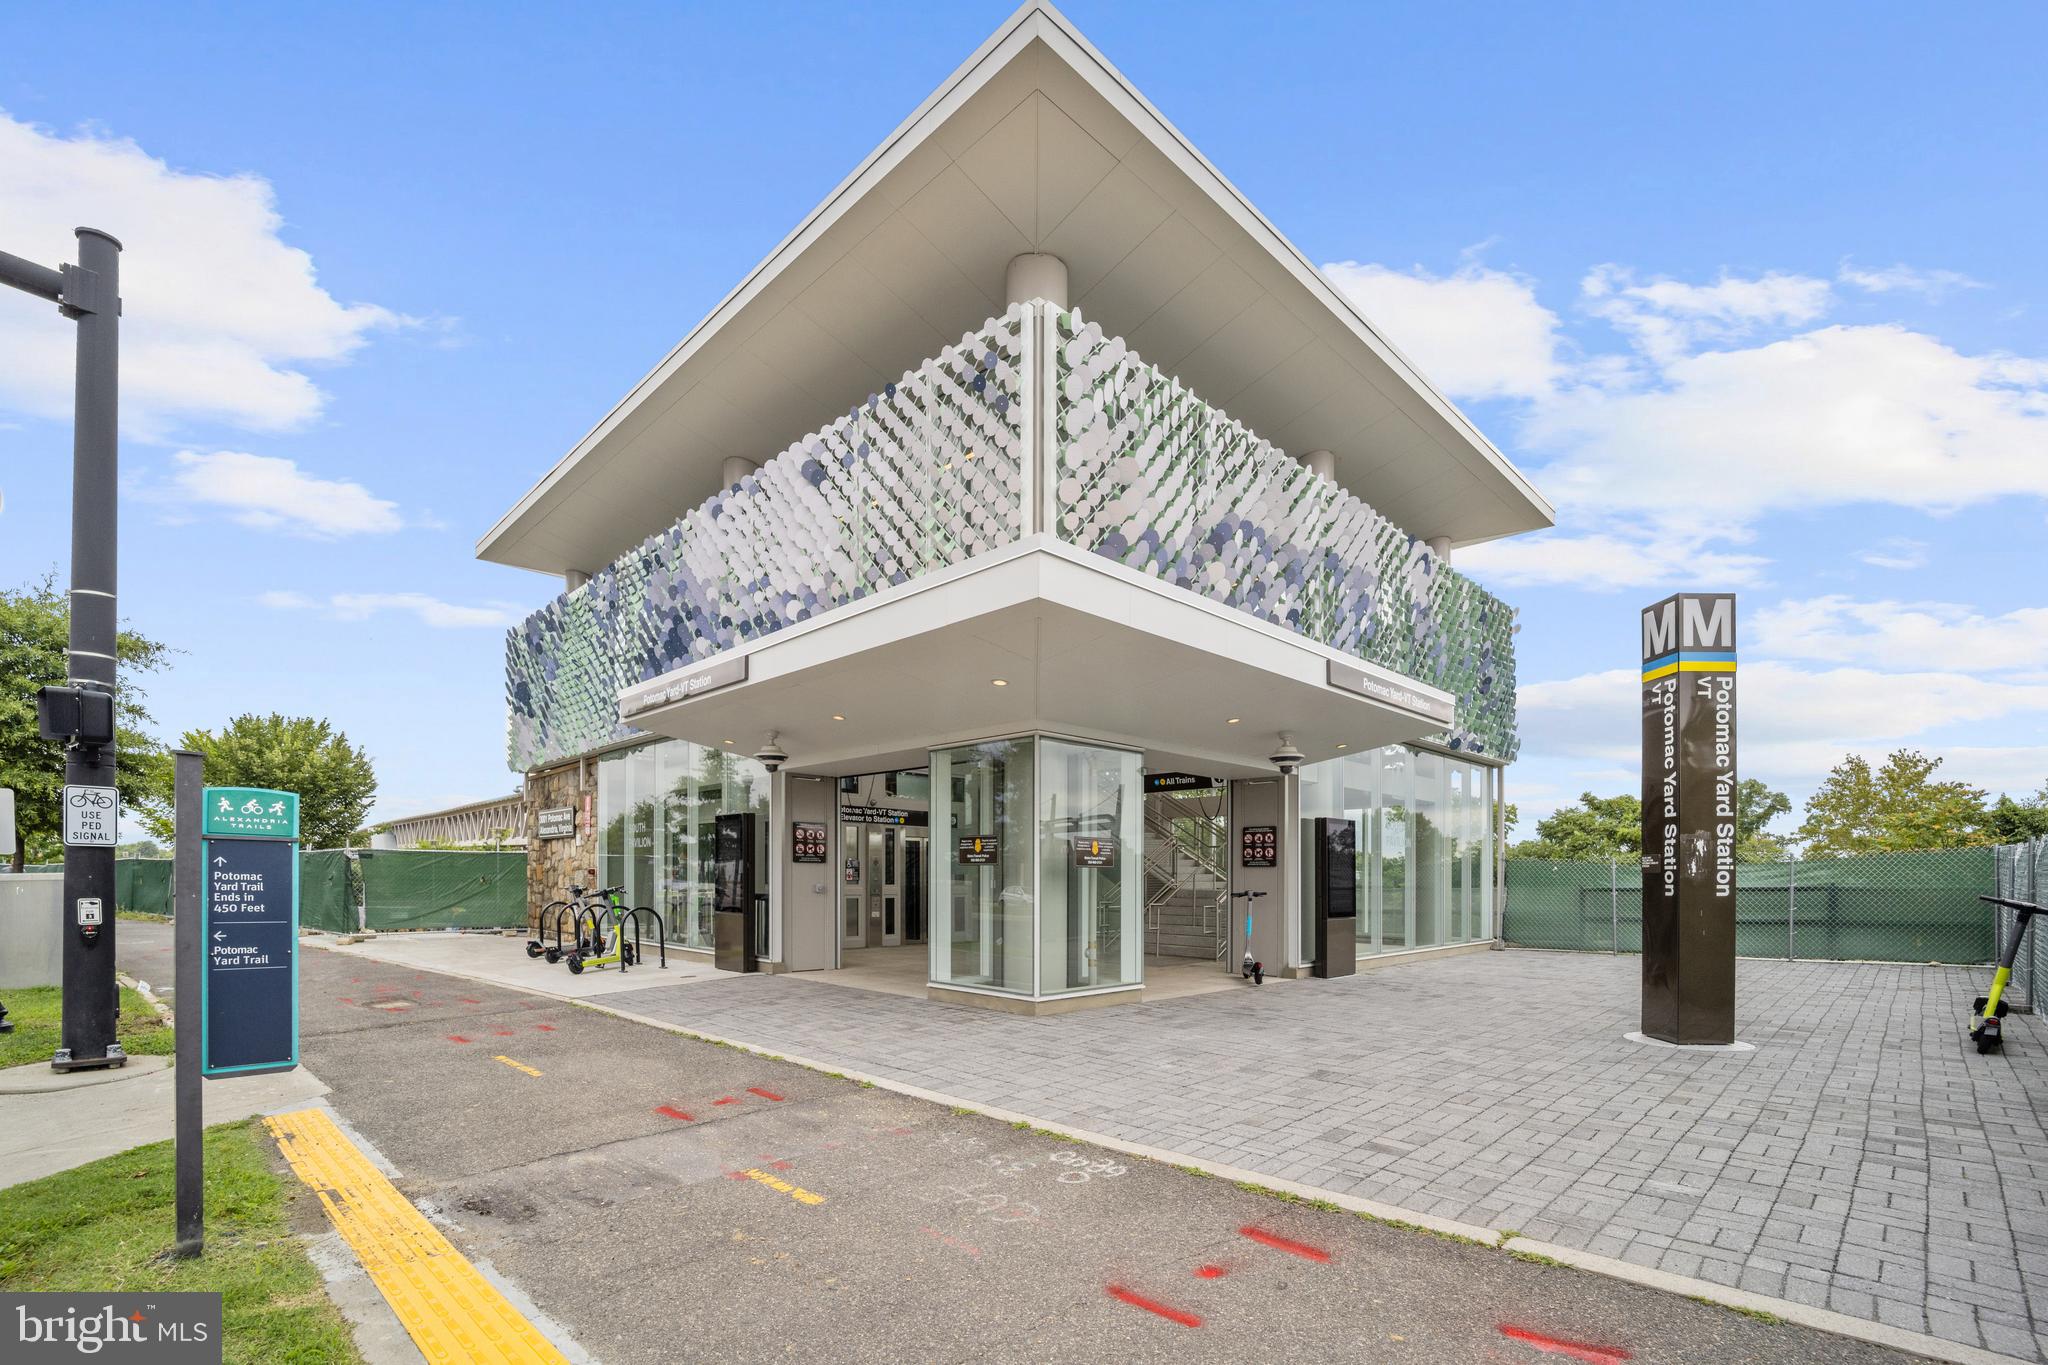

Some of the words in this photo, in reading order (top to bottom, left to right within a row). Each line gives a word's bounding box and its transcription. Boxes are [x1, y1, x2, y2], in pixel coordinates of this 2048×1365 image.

[1683, 599, 1732, 647] M
[1644, 601, 1675, 659] M
[643, 689, 666, 705] Potomac
[665, 680, 689, 698] Yard-VT
[689, 675, 712, 691] Station
[1652, 682, 1661, 704] VT
[1697, 676, 1712, 699] VT
[1363, 677, 1390, 697] Potomac
[1389, 687, 1412, 705] Yard-VT
[1411, 695, 1431, 711] Station
[1664, 678, 1677, 769] Potomac
[1716, 676, 1733, 768] Potomac
[1175, 776, 1196, 784] Trains
[1664, 771, 1677, 818] Yard
[1716, 770, 1734, 817] Yard
[81, 811, 102, 819] USE
[863, 807, 887, 816] Yard-VT
[887, 809, 909, 817] Station
[214, 816, 288, 825] ALEXANDRIA
[873, 815, 895, 823] Station
[81, 821, 102, 830] PED
[72, 831, 110, 841] SIGNAL
[1664, 824, 1677, 897] Station
[1715, 823, 1734, 897] Station
[214, 871, 263, 881] Potomac
[214, 882, 238, 891] Yard
[240, 882, 264, 891] Trail
[214, 892, 240, 902] Ends
[243, 892, 254, 901] in
[214, 904, 238, 913] 450
[241, 903, 265, 912] Feet
[214, 946, 258, 955] Potomac
[214, 956, 240, 966] Yard
[243, 954, 269, 964] Trail
